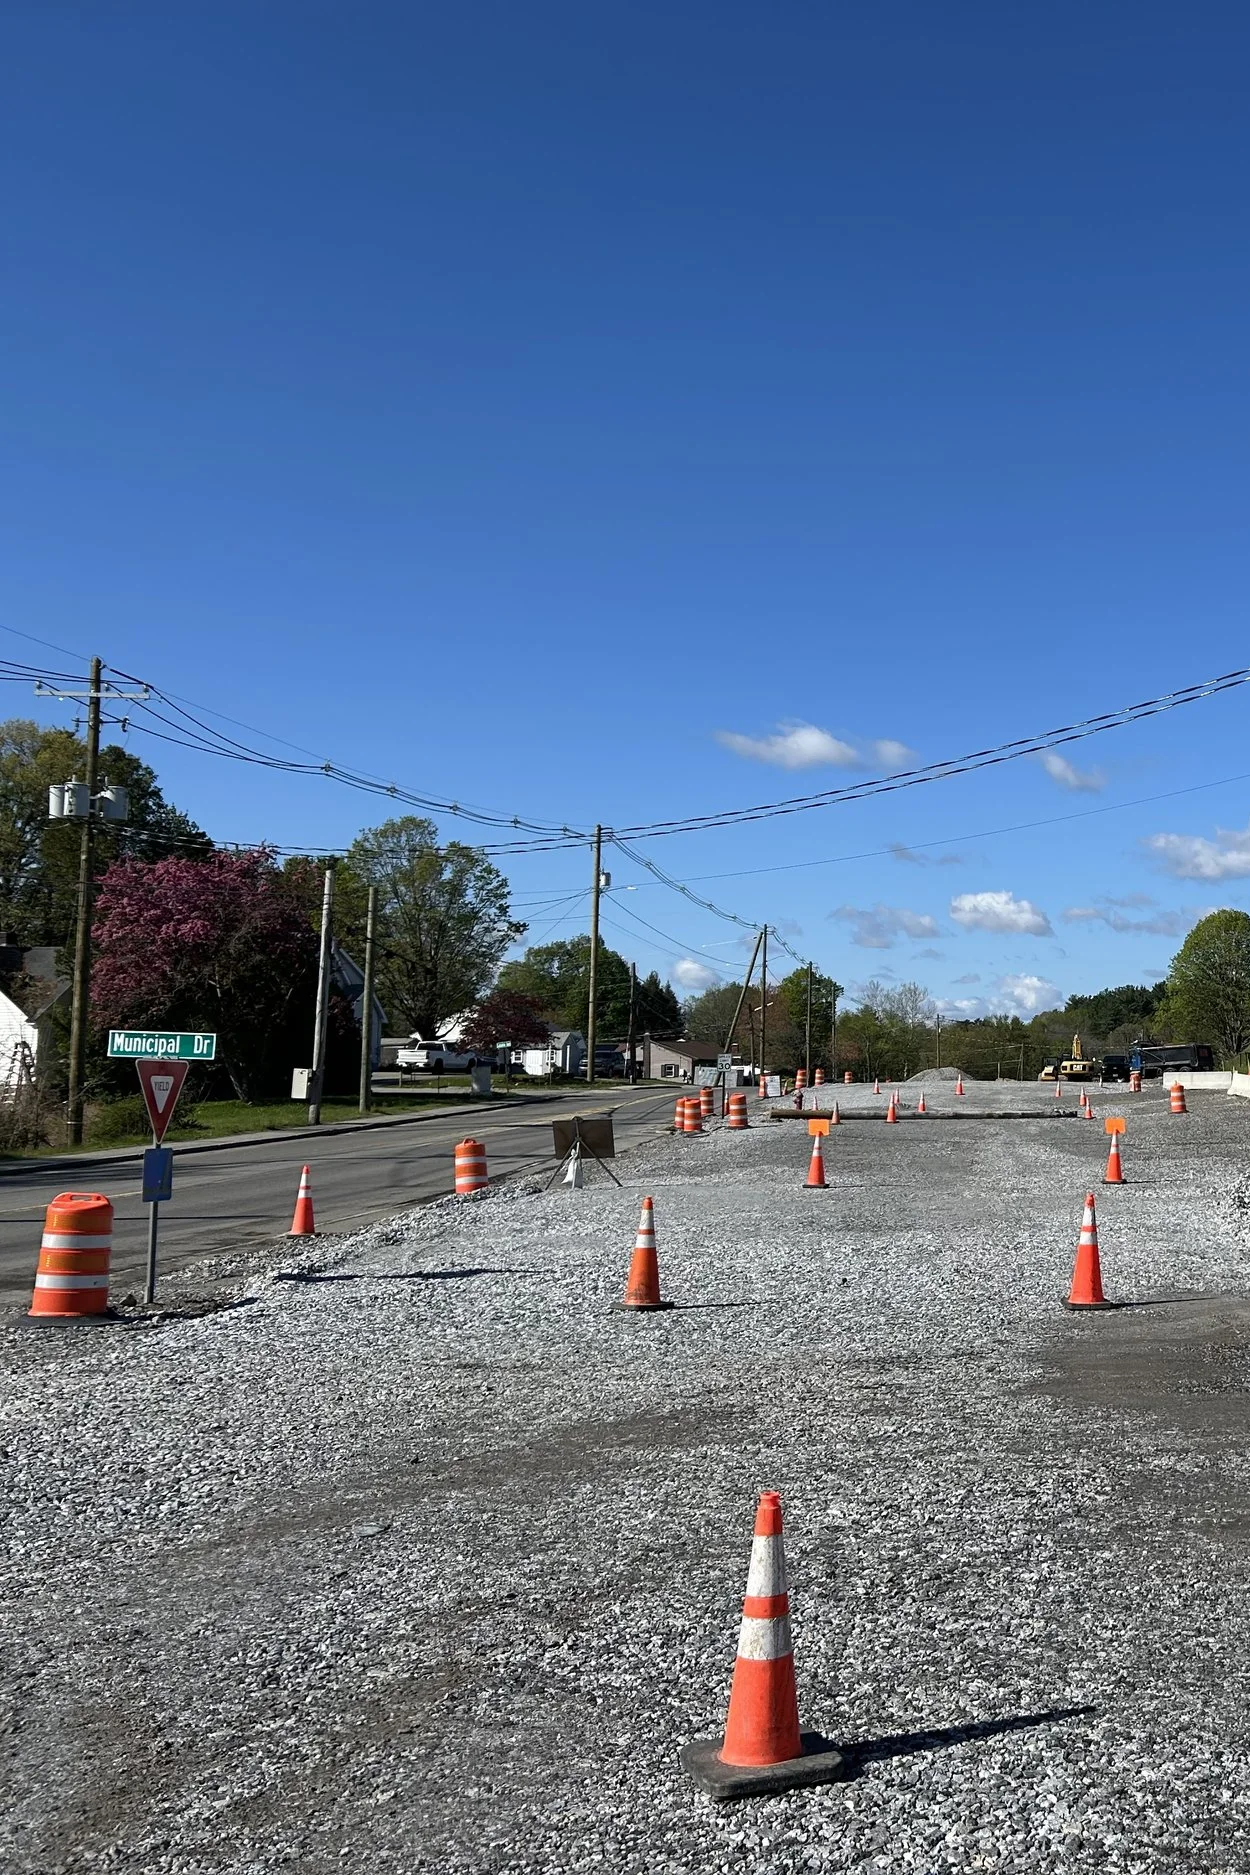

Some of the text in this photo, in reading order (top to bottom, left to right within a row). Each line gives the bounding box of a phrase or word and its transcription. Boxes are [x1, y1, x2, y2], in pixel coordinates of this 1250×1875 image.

[113, 1033, 211, 1056] Municipal Dr
[154, 1082, 170, 1091] YIELD
